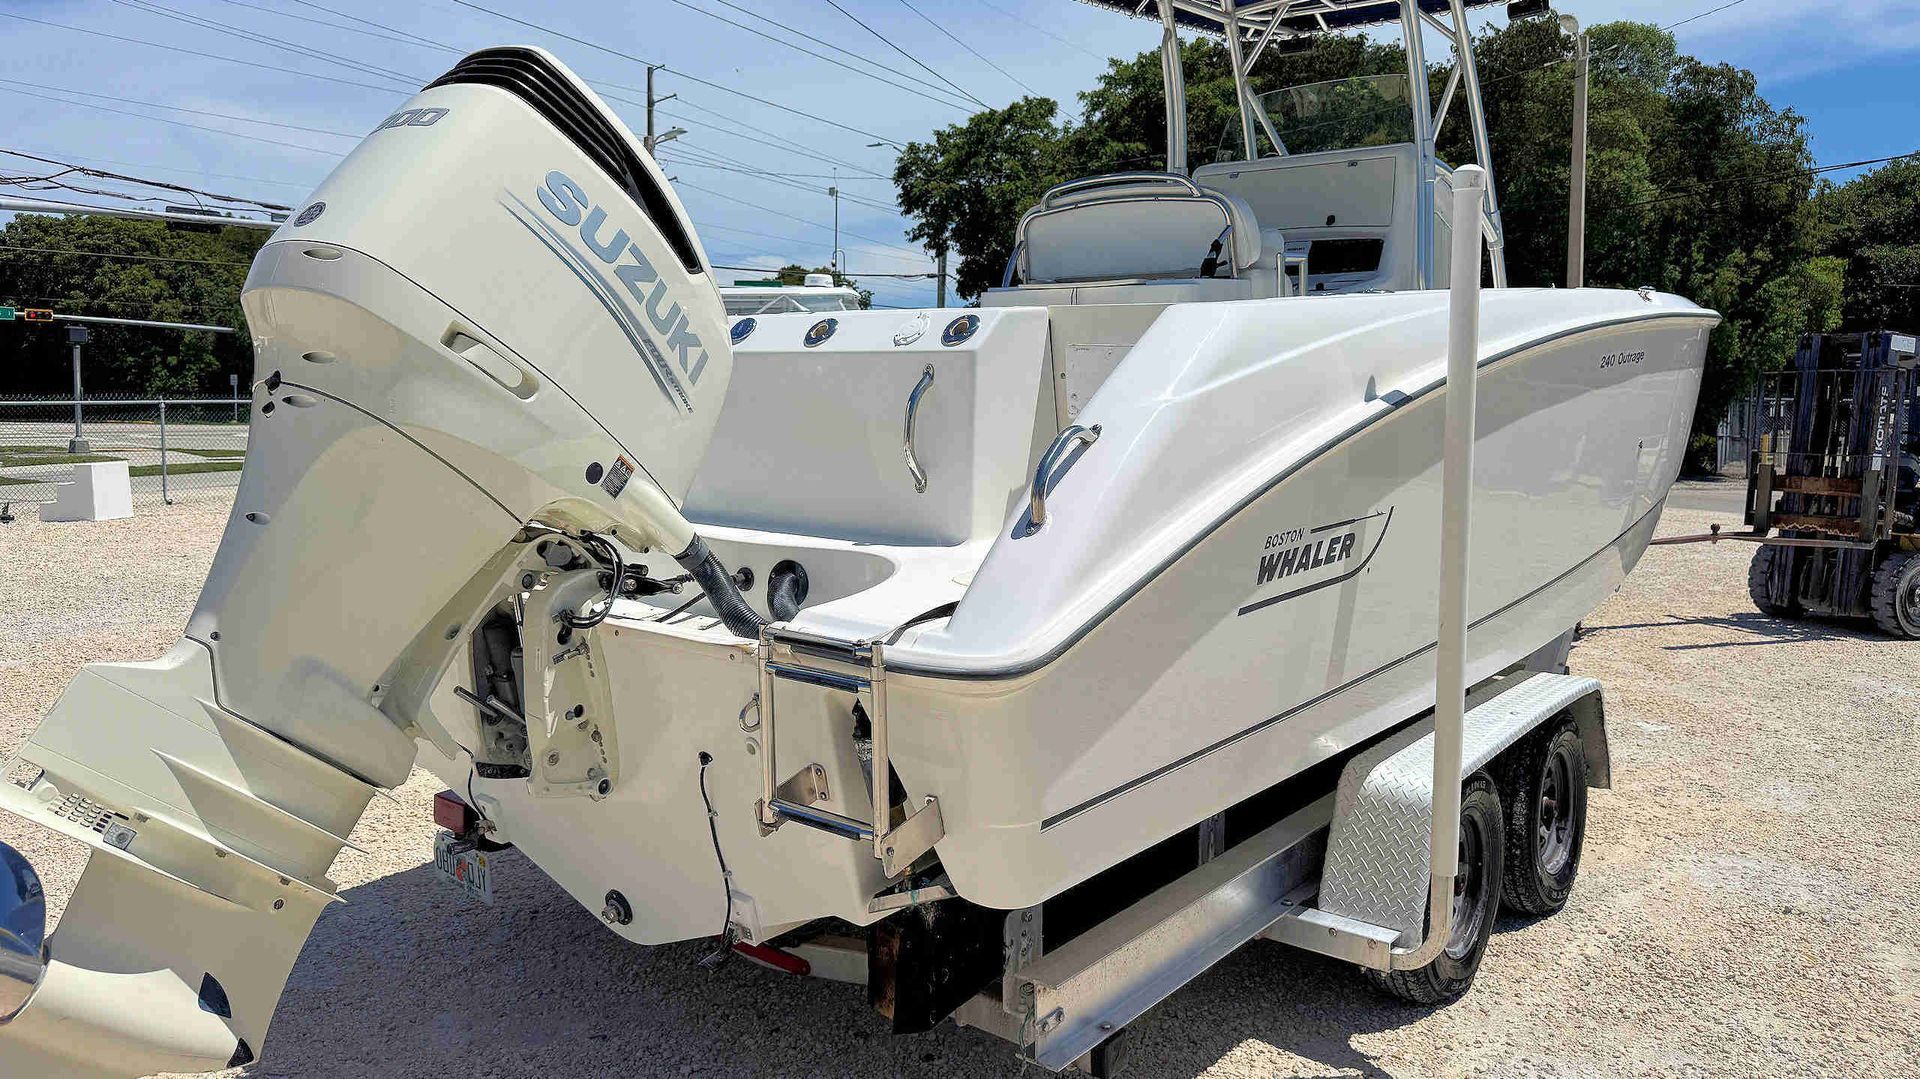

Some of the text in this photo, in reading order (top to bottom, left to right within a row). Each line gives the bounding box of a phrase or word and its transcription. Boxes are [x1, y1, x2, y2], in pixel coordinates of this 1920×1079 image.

[536, 170, 709, 386] SUZUKI
[1600, 351, 1645, 369] 240 Outrage
[1264, 528, 1305, 550] BOSTON
[1256, 532, 1356, 586] WHALER
